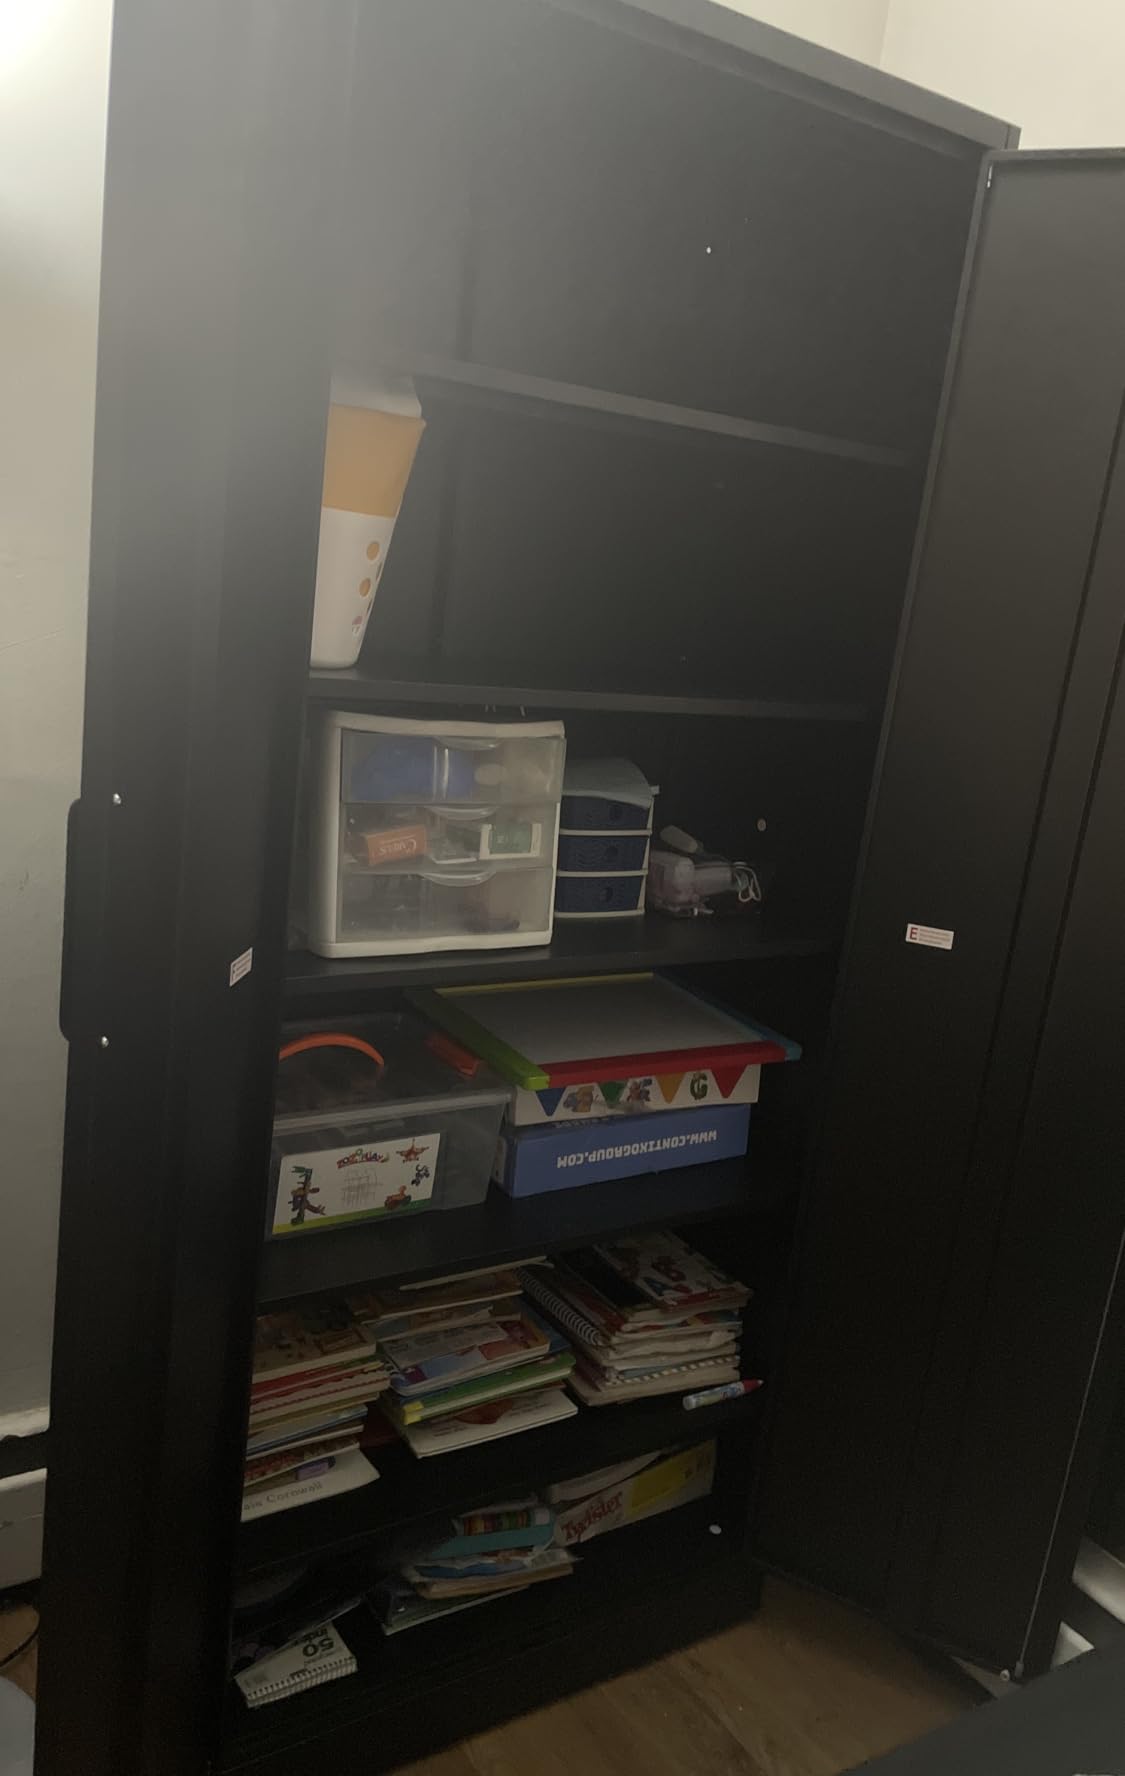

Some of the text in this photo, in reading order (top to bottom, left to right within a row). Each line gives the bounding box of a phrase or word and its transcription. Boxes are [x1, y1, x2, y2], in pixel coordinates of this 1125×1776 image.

[909, 927, 918, 940] E
[557, 1130, 717, 1168] WWW.CONTIXOGROUP.COM
[561, 1491, 623, 1537] Twister
[302, 1638, 334, 1657] 50
